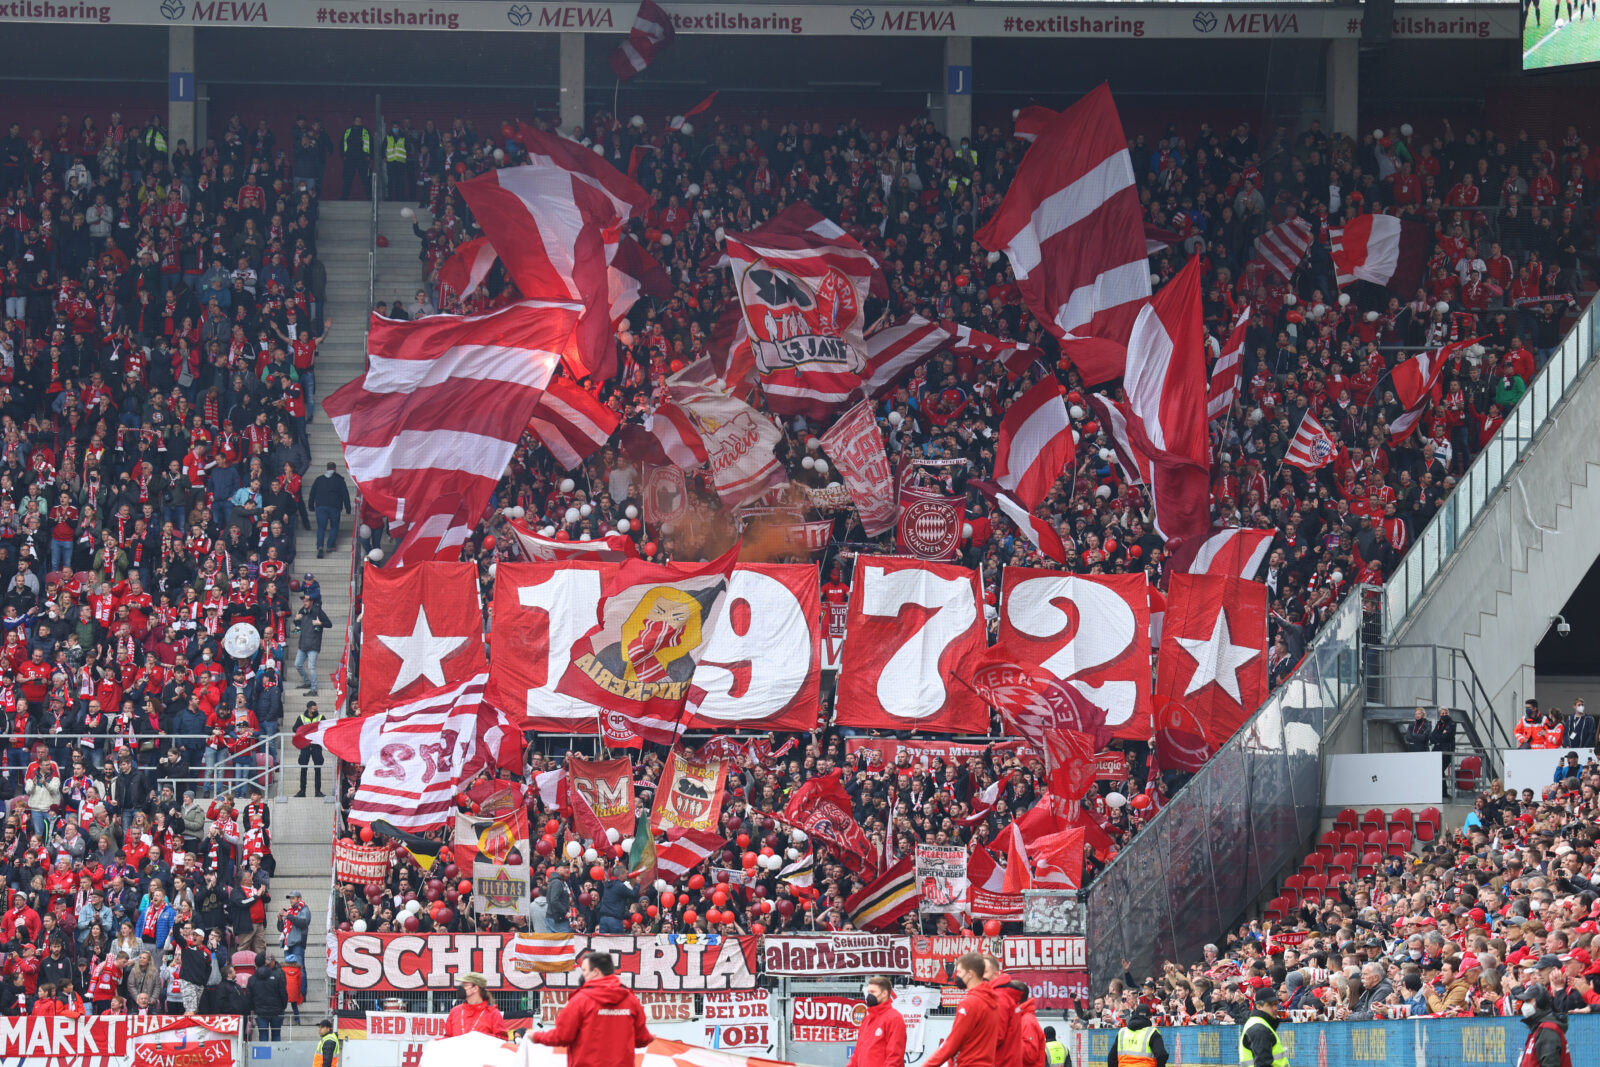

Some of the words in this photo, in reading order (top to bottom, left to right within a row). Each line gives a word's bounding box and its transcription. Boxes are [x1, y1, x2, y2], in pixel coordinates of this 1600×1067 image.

[191, 6, 268, 22] MEWA
[316, 7, 459, 30] #textilsharing
[538, 7, 614, 27] MEWA
[881, 11, 956, 31] MEWA
[1224, 13, 1299, 33] MEWA
[1003, 16, 1145, 37] #textilsharing
[1346, 17, 1490, 37] #tilsharing
[955, 70, 964, 93] J
[482, 880, 522, 896] ULTRAS
[1004, 939, 1087, 967] COLEGIO
[915, 959, 941, 979] RED
[706, 992, 733, 1003] WIR
[735, 989, 769, 1001] SIND
[651, 1005, 691, 1020] UNS
[705, 1006, 735, 1019] BEI
[739, 1003, 769, 1017] DIR
[795, 999, 852, 1023] SÜDTIR
[0, 1015, 126, 1056] MARKT
[371, 1016, 406, 1035] RED
[793, 1026, 837, 1041] LETZTE
[705, 1026, 769, 1046] TOBI
